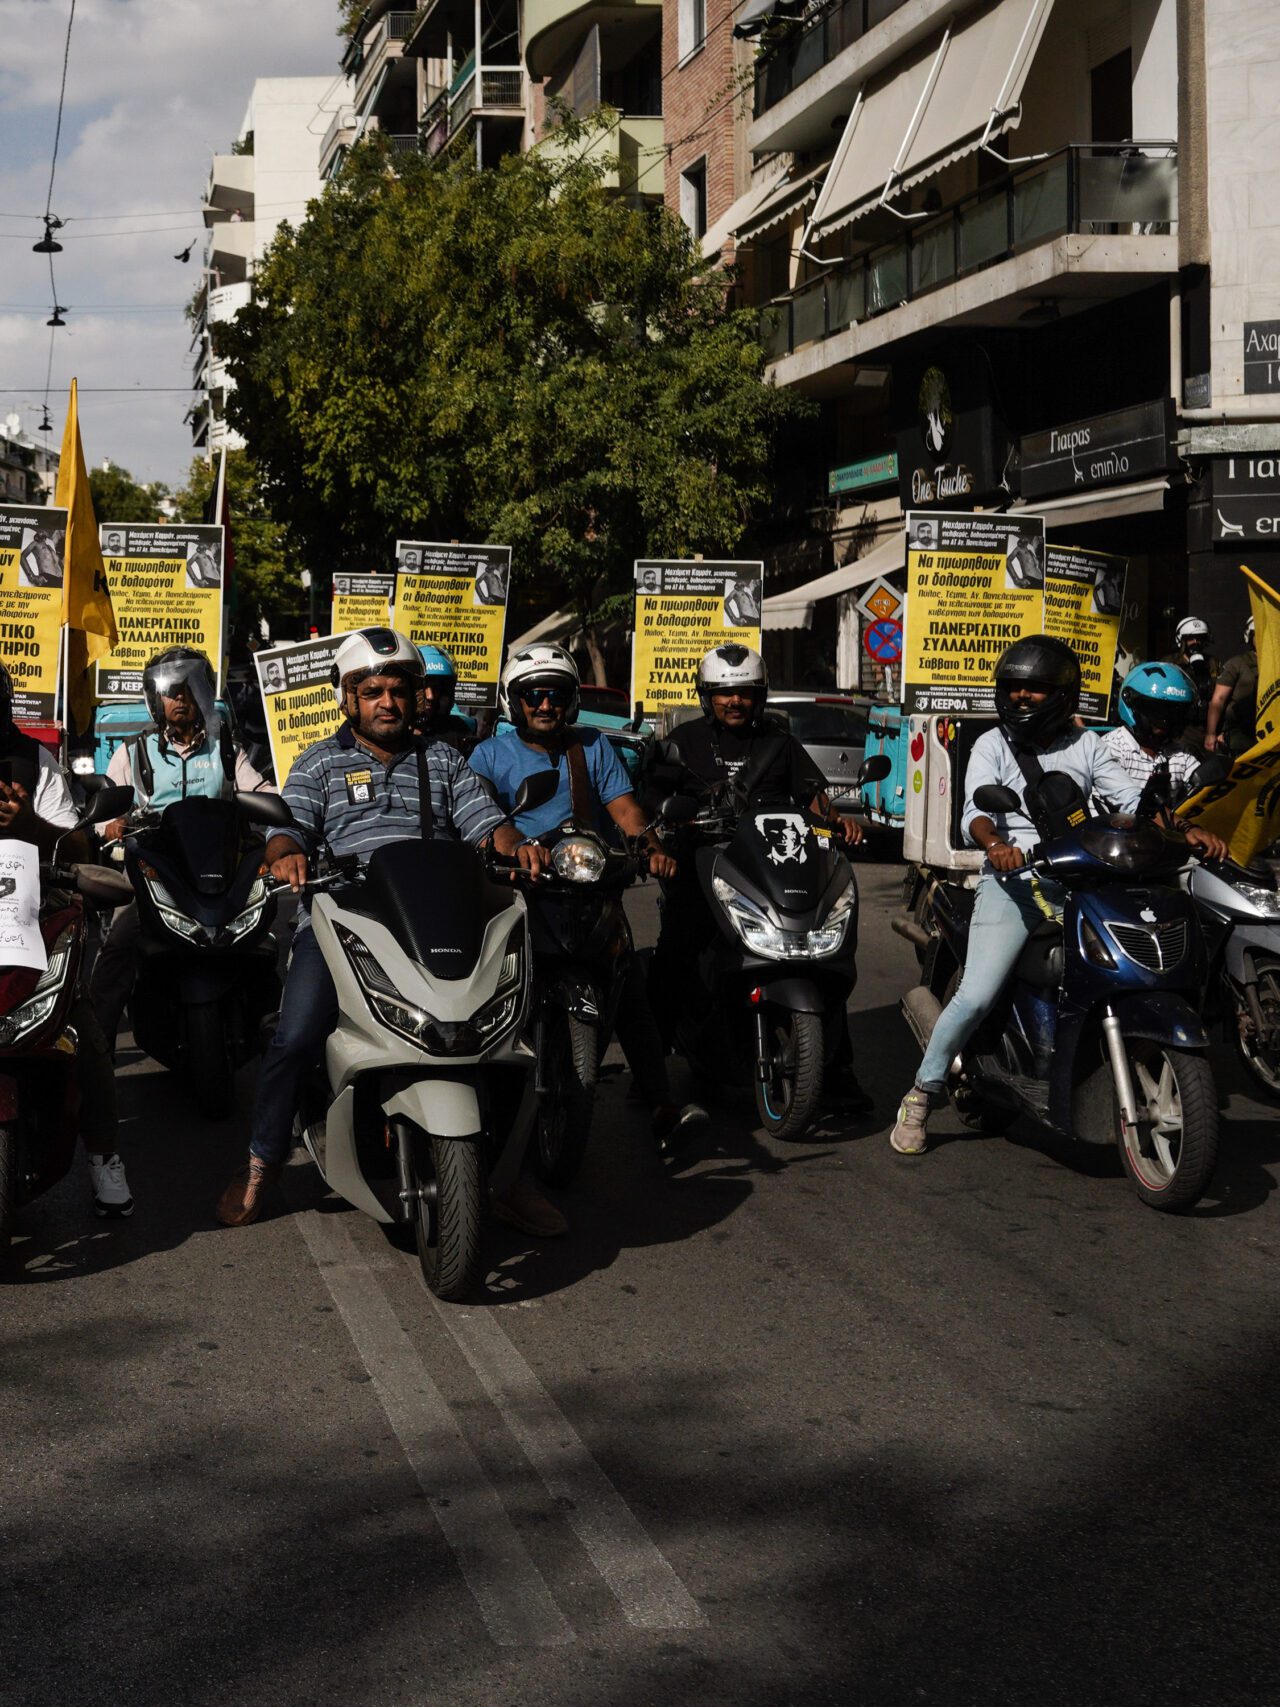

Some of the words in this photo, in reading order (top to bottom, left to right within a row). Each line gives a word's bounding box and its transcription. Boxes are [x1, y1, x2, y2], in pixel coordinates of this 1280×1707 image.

[912, 469, 931, 503] One
[942, 521, 971, 530] Μοχάμεντ
[109, 560, 121, 571] Να
[125, 561, 181, 574] τιμωρηθούν
[918, 554, 933, 568] Να
[937, 555, 1001, 571] τιμωρηθούν
[108, 577, 117, 587] οι
[121, 575, 174, 588] δολοφόνοι
[404, 577, 416, 588] Να
[419, 579, 471, 591] τιμωρηθούν
[917, 574, 928, 586] οι
[932, 572, 992, 588] δολοφόνοι
[339, 597, 347, 605] Να
[403, 592, 412, 601] οι
[414, 591, 463, 604] δολοφόνοι
[918, 589, 943, 598] Πύλος,
[983, 591, 1034, 602] Παντελεήμονας
[18, 601, 29, 609] την
[644, 598, 657, 610] Να
[661, 598, 719, 611] τιμωρηθούν
[949, 600, 992, 609] τελειώνουμε
[644, 615, 653, 626] οι
[656, 613, 711, 626] δολοφόνοι
[928, 609, 967, 618] κυβέρνηση
[983, 610, 1024, 619] δολοφόνων
[119, 617, 199, 630] ΠΑΝΕΡΓΑΤΙΚΟ
[930, 622, 1021, 637] ΠΑΝΕΡΓΑΤΙΚΟ
[410, 630, 484, 643] ΠΑΝΕΡΓΑΤΙΚΟ
[111, 647, 146, 658] Σάββατο
[654, 657, 702, 669] ΠΑΝΕΡΓ
[919, 658, 959, 670] Σάββατο
[964, 658, 975, 670] 12
[932, 673, 956, 681] Πλατεία
[958, 674, 988, 682] Βικτωρίας
[646, 688, 682, 700] Σάββατο
[687, 688, 697, 699] 12
[274, 697, 286, 712] Να
[931, 698, 968, 710] ΚΕΕΡΦΑ
[278, 718, 286, 731] οι
